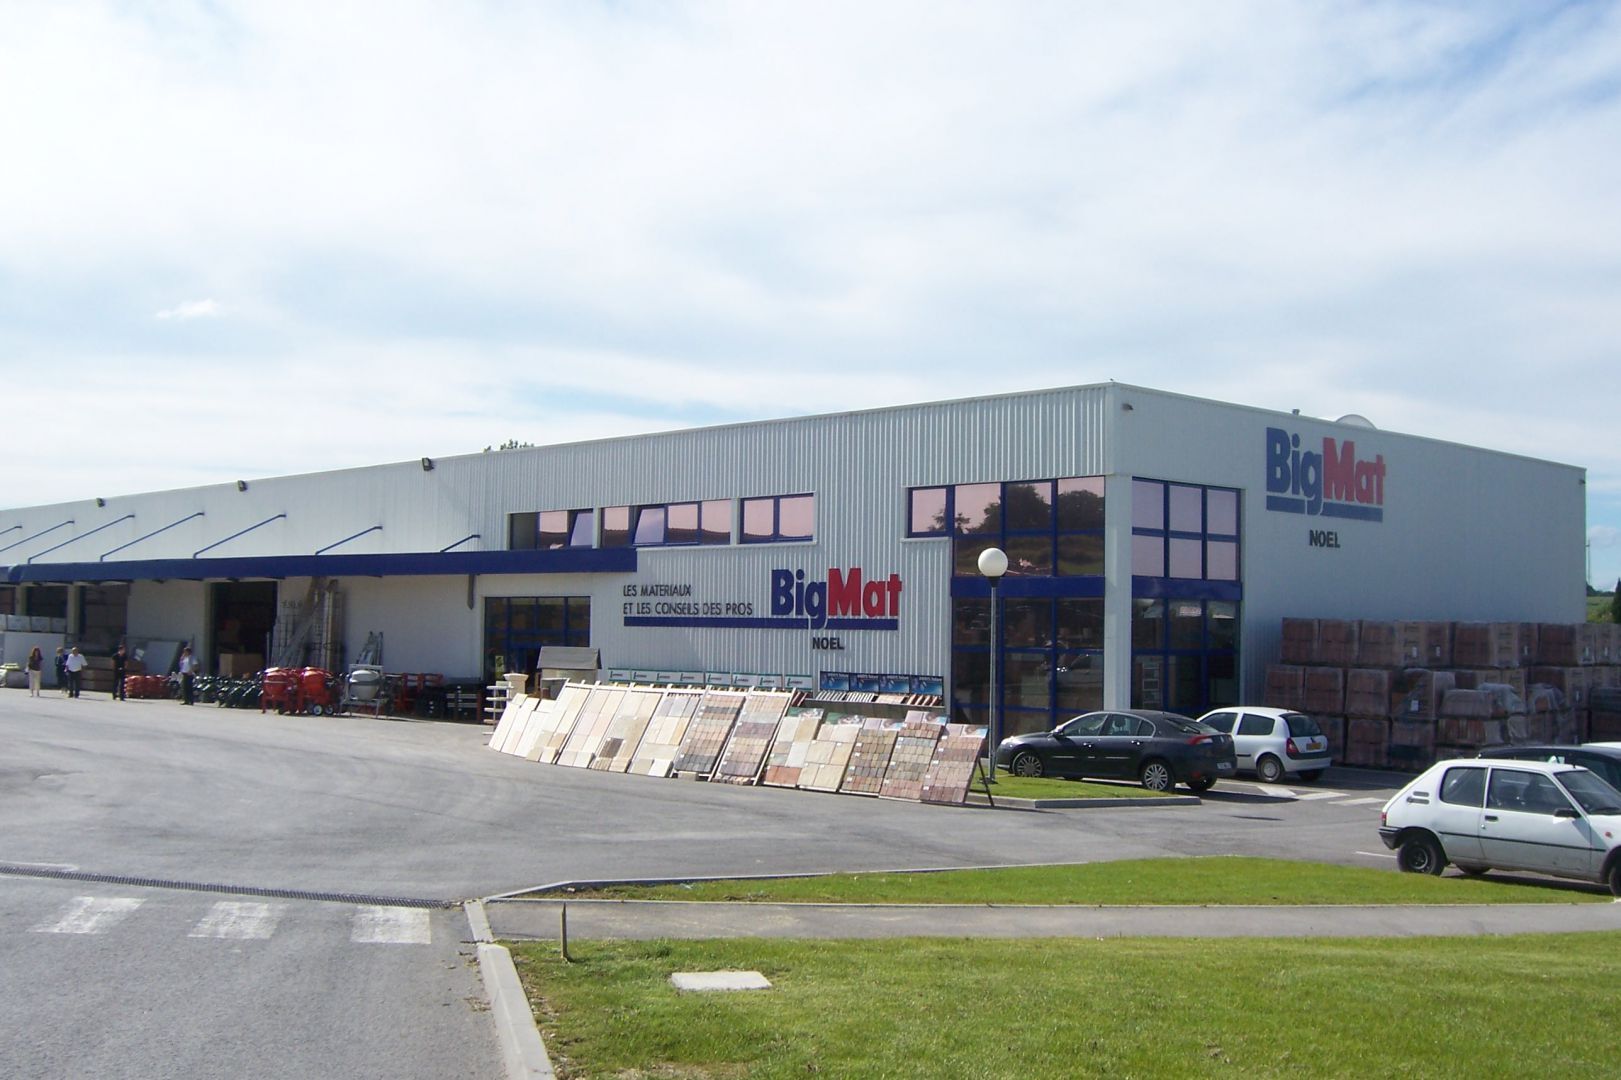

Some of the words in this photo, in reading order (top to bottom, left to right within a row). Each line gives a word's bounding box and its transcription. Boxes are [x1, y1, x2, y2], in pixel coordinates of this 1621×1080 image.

[1266, 426, 1386, 516] BigMat
[1309, 529, 1341, 549] NOEL
[623, 584, 637, 597] LES
[640, 584, 691, 597] MATERIAUX
[771, 568, 902, 629] BigMat
[623, 602, 633, 615] ET
[636, 602, 651, 615] LES
[654, 602, 699, 616] CONSEILS
[702, 602, 722, 616] DES
[725, 602, 753, 616] PROS
[812, 637, 845, 650] NOEL
